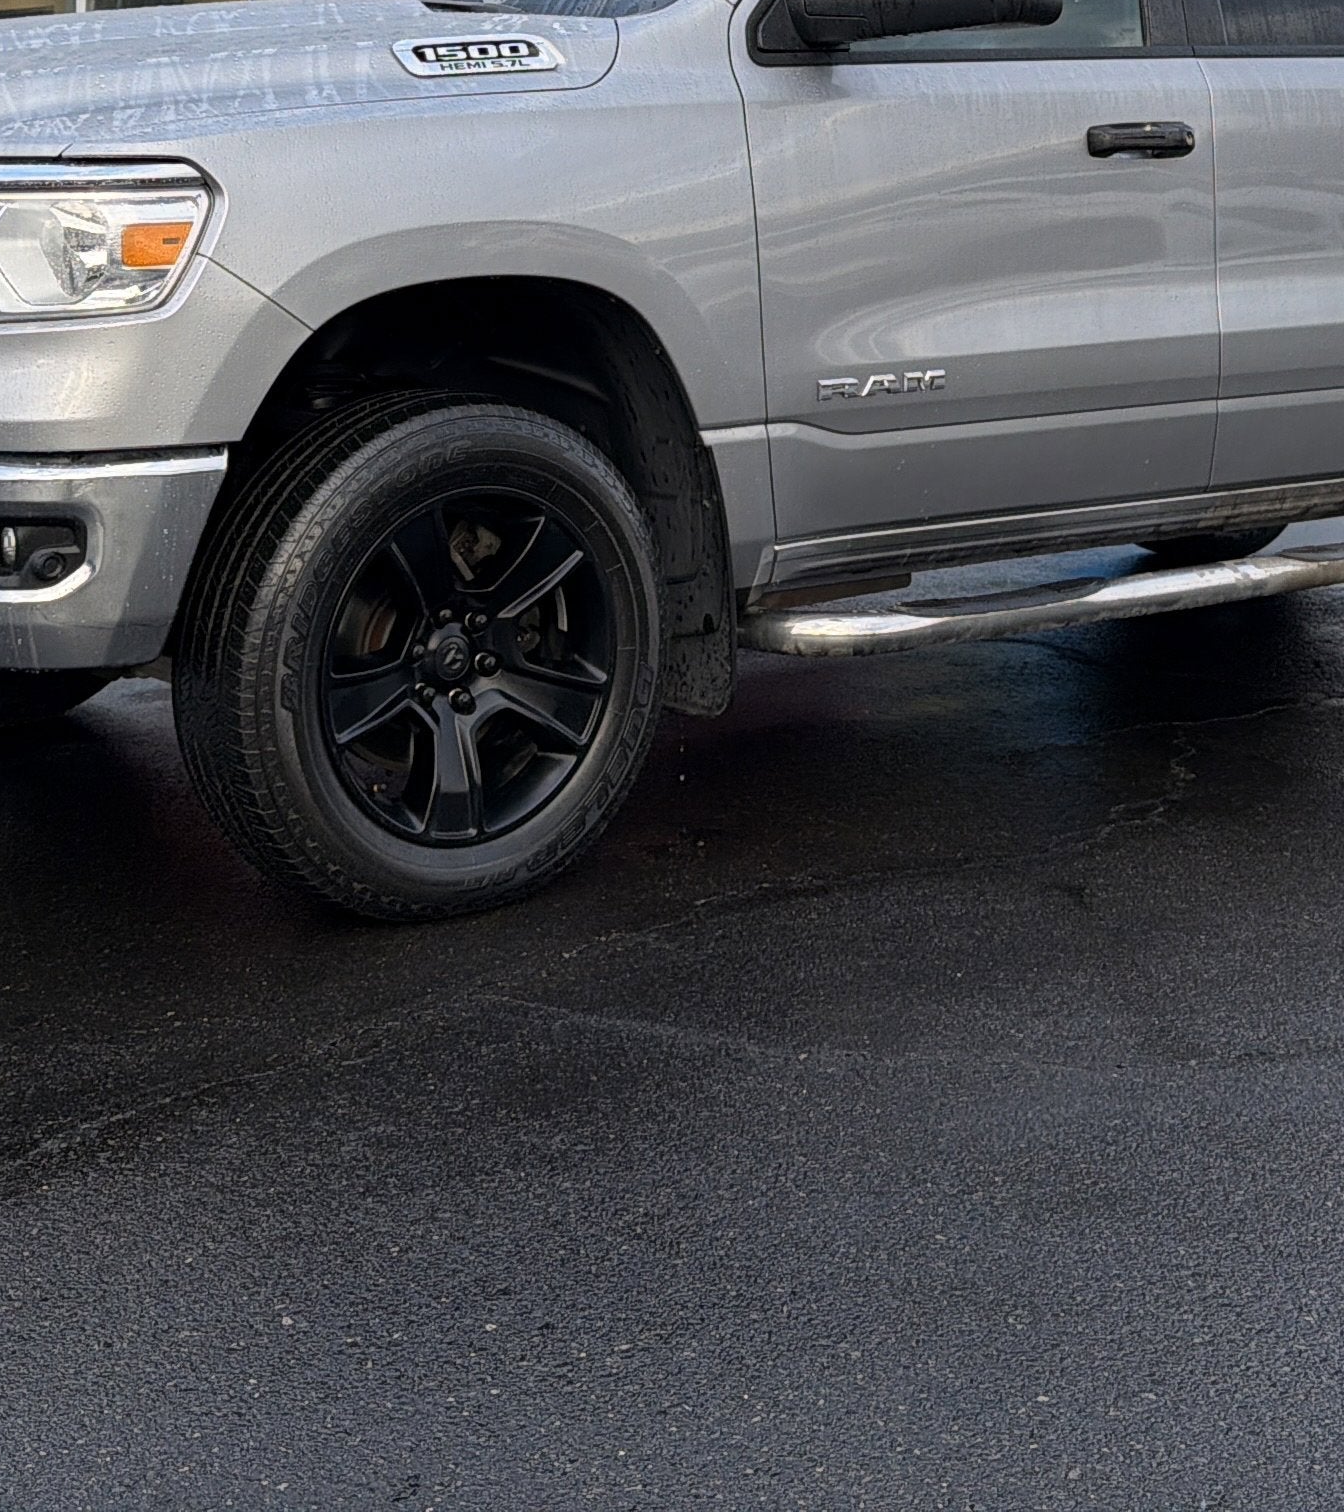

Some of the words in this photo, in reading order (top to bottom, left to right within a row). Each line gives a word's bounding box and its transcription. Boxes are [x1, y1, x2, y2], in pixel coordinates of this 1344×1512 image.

[417, 42, 530, 62] 1500
[439, 61, 488, 72] HEMI
[490, 58, 531, 69] 5.7L
[816, 368, 946, 402] RAM
[280, 439, 474, 712] BRIDGESTONE
